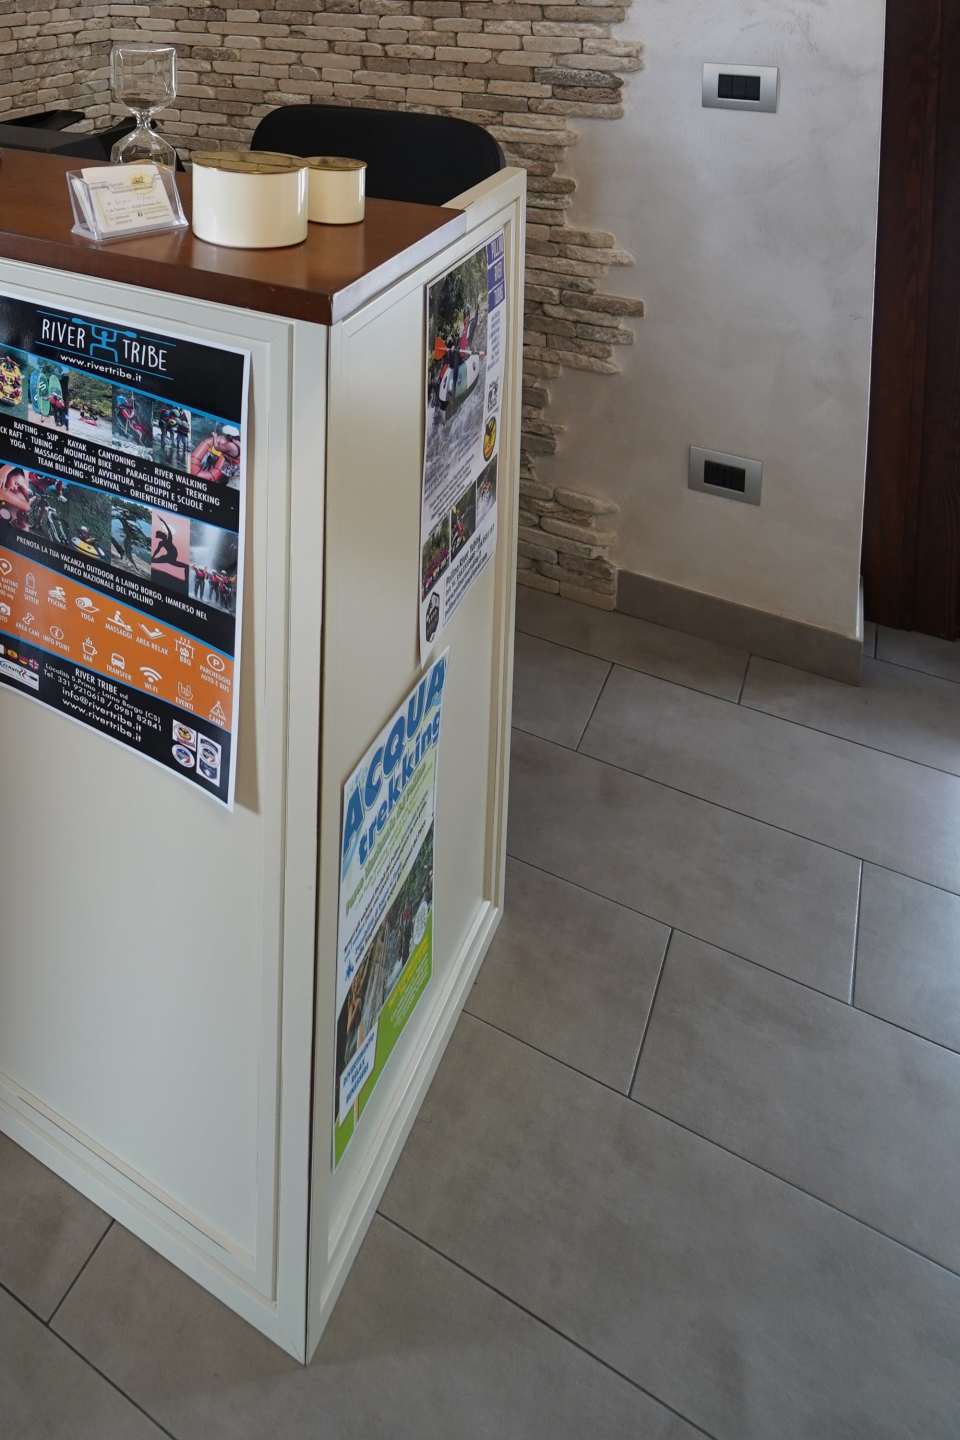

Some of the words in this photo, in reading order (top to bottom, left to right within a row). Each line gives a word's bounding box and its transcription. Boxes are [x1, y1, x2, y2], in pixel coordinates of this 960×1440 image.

[42, 318, 86, 349] RIVER
[122, 338, 167, 371] TRIBE
[60, 353, 143, 383] www.rivertribe.it
[8, 429, 23, 440] RAFT
[31, 436, 53, 449] TUBING
[63, 447, 97, 464] MOUNTAIN
[98, 458, 112, 470] BIKE
[125, 468, 171, 489] PARAGLIDING
[185, 488, 220, 506] TREKKING
[10, 439, 26, 450] YOGA
[34, 447, 65, 463] MASSAGGI
[74, 460, 95, 473] VIAGGI
[98, 469, 134, 487] AVVENTURA
[144, 485, 169, 499] GRUPPI
[177, 494, 203, 511] SCUOLE
[13, 421, 38, 436] RAFTING
[46, 432, 59, 442] SUP
[67, 439, 87, 452] KAYAK
[97, 448, 136, 468] CANYONING
[154, 467, 174, 480] RIVER
[175, 473, 208, 492] WALKING
[37, 457, 54, 468] TEAM
[55, 463, 84, 479] BUILDING
[91, 475, 120, 492] SURVIVAL
[130, 488, 178, 512] ORIENTEERING
[16, 536, 40, 550] PRENOTA
[41, 546, 48, 554] LA
[49, 549, 59, 559] TUA
[60, 553, 85, 569] VACANZA
[86, 563, 114, 580] OUTDOOR
[121, 578, 139, 591] LAINO
[165, 596, 194, 614] IMMERSO
[196, 609, 208, 621] NEL
[64, 563, 82, 576] PARCO
[83, 572, 114, 590] NAZIONALE
[116, 584, 127, 595] DEL
[128, 590, 154, 606] POLLINO
[81, 612, 95, 623] YOGA
[105, 623, 132, 639] MASSAGGI
[136, 637, 150, 649] AREA
[151, 643, 169, 656] RELAX
[44, 669, 55, 680] Tel.
[58, 676, 70, 687] 331
[114, 703, 133, 718] 0981
[75, 668, 95, 684] RIVER
[97, 678, 118, 695] TRIBE
[102, 691, 120, 703] Laino
[122, 699, 143, 715] Borgo
[62, 687, 142, 732] info@rivertribe.it
[62, 699, 142, 742] www.rivertribe.it
[343, 657, 445, 855] ACQUA
[358, 710, 440, 865] trekking
